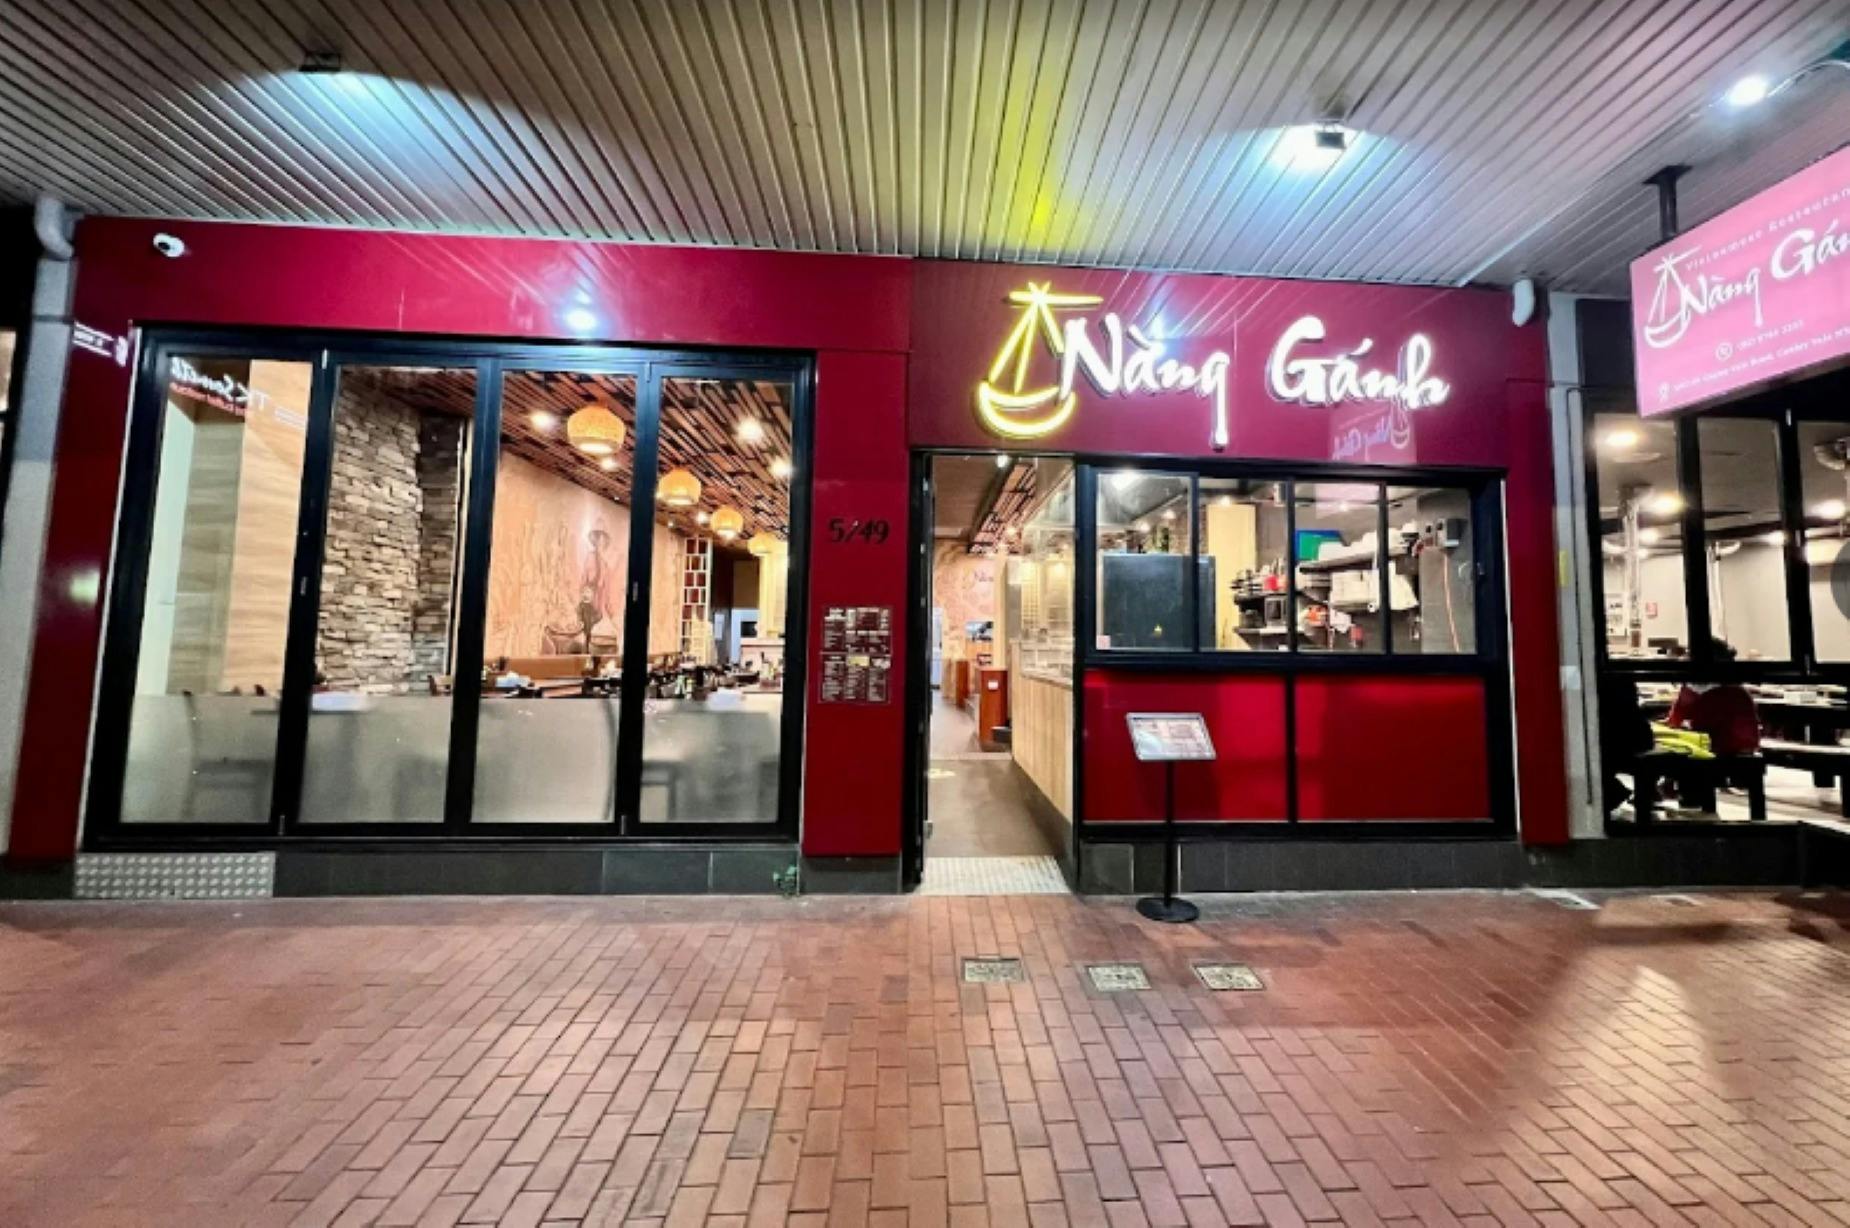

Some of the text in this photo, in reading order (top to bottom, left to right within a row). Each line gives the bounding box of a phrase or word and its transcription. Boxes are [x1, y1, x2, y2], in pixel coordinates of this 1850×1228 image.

[1059, 312, 1450, 446] Nàng Gánh
[827, 517, 890, 545] 5/49
